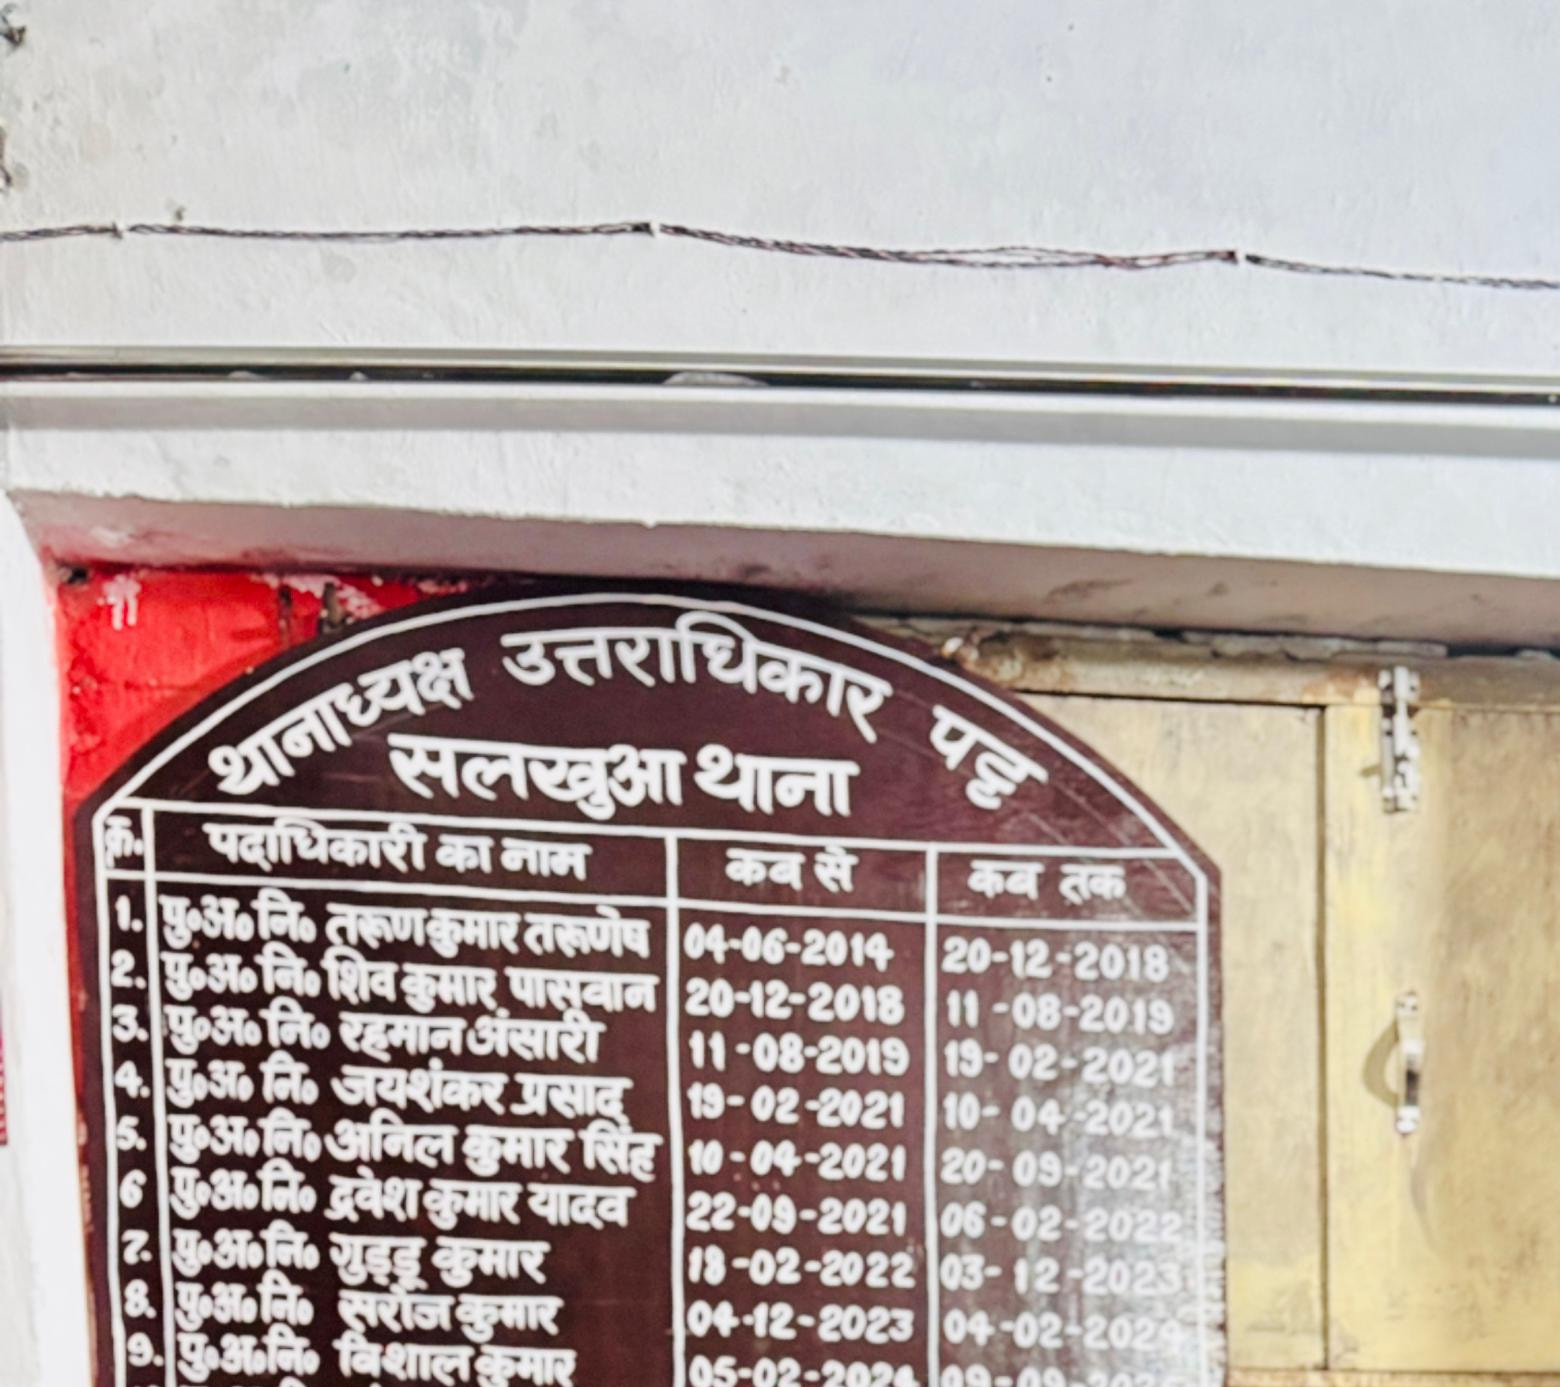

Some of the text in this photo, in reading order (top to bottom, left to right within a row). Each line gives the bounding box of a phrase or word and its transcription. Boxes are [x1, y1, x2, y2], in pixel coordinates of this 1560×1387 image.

[208, 647, 474, 795] थानाध्यक्ष
[501, 611, 892, 744] उत्तराधिकार
[387, 731, 860, 819] सलखुआ थाना
[203, 817, 428, 873] पदाधिकारी
[435, 834, 495, 874] का
[500, 839, 591, 880] नाम
[725, 847, 805, 891] कब
[814, 843, 859, 892] से
[967, 859, 1043, 900] कब
[1058, 862, 1127, 905] तक
[426, 908, 521, 958] कुमार
[683, 921, 894, 972] 04-06-2014
[941, 936, 1169, 982] 20-12-2018
[320, 944, 398, 1005] शिव
[401, 963, 497, 1014] कुमार
[504, 967, 660, 1013] पासवान
[685, 977, 905, 1025] 20-12-2018
[339, 1011, 467, 1062] रहमान
[466, 1007, 606, 1062] अंसारी
[331, 1057, 509, 1114] जयशंकर
[511, 1073, 633, 1126] प्रसाद
[324, 1108, 459, 1167] अनिल
[462, 1124, 575, 1176] कुमार
[578, 1118, 663, 1182] सिंह
[423, 1179, 523, 1230] कुमार
[527, 1183, 637, 1230] यादव
[431, 1236, 551, 1288] कुमार
[338, 1284, 455, 1333] सरोज
[456, 1294, 564, 1343] कुमार
[687, 1301, 915, 1345] 04-12-2023
